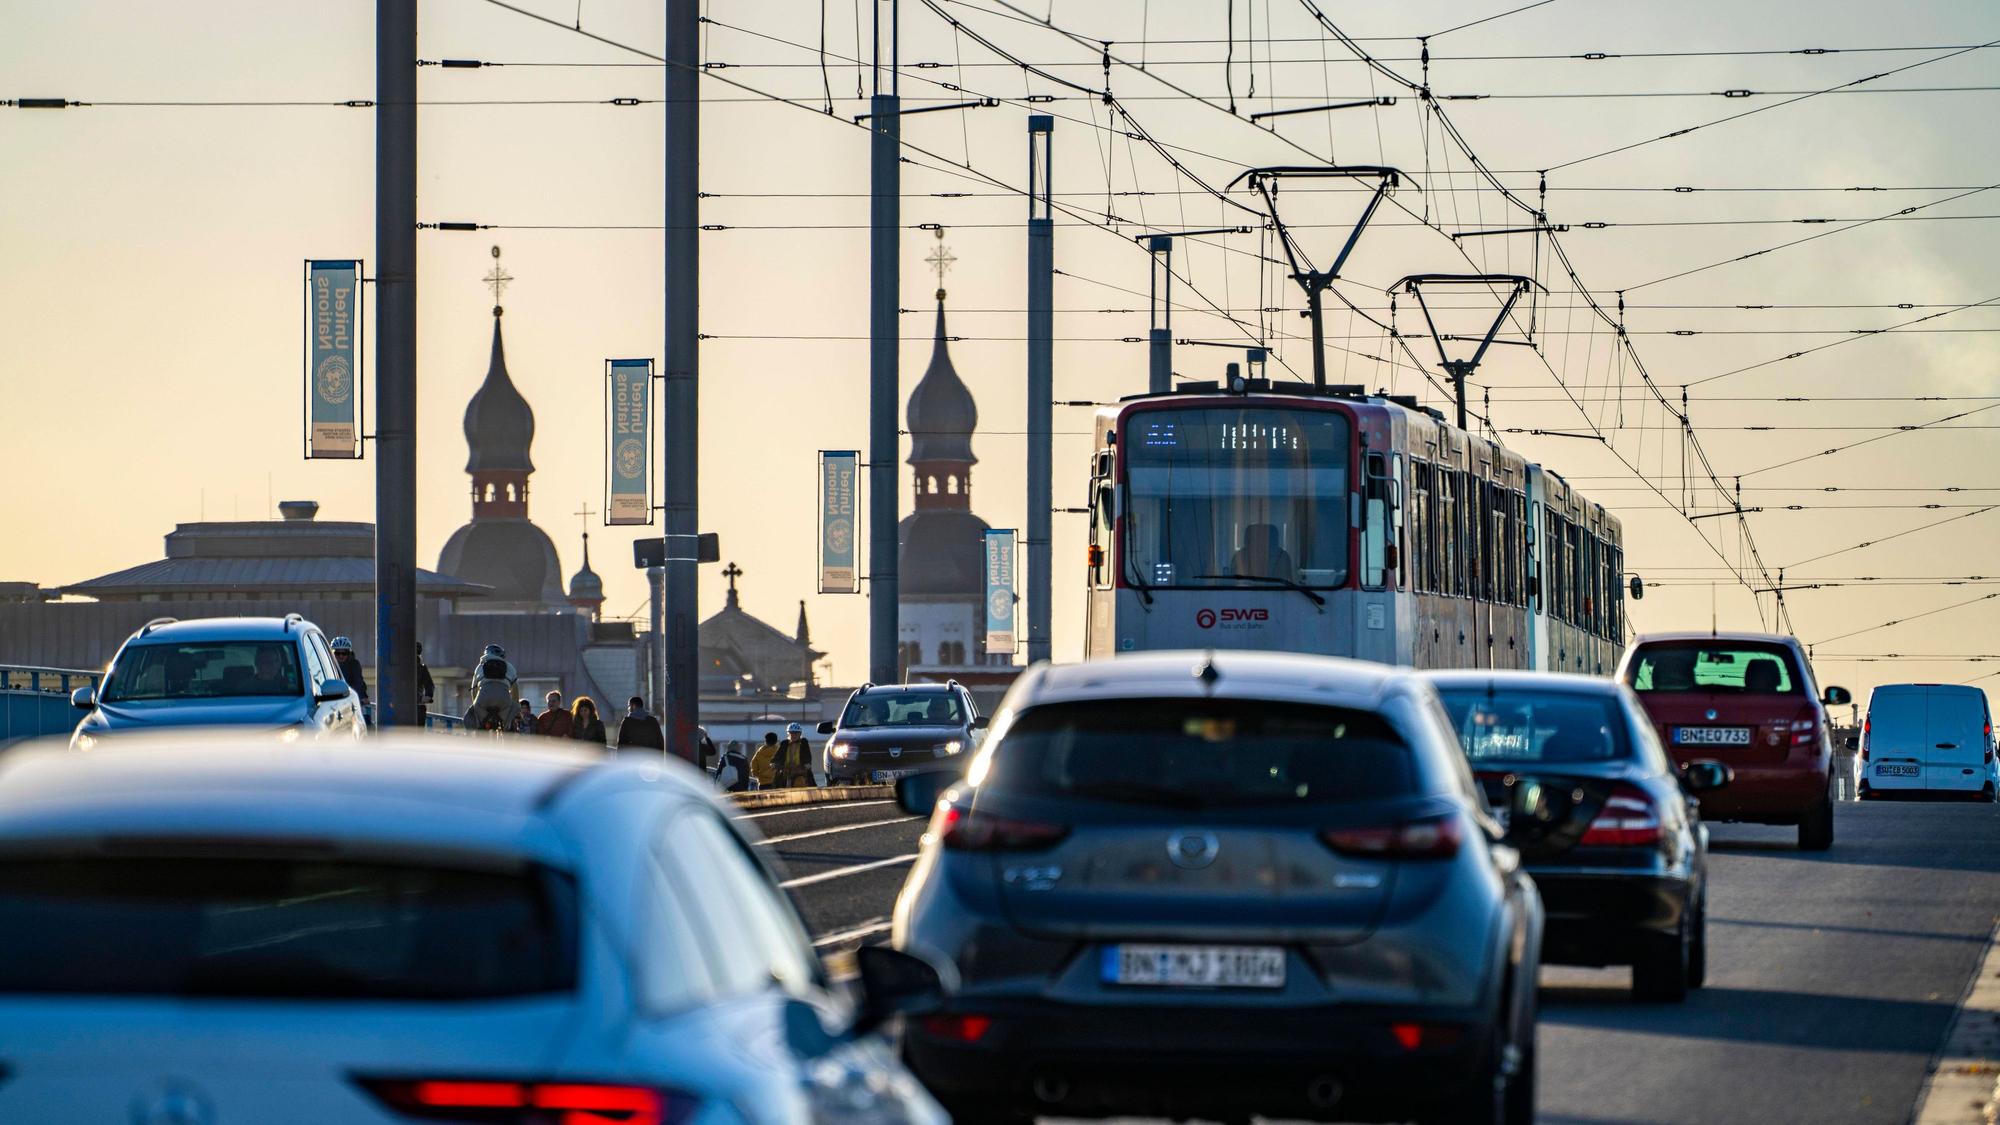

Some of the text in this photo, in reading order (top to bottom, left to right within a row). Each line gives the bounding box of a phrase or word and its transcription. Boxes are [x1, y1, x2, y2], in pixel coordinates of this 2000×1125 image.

[1221, 609, 1269, 620] SWB
[1680, 730, 1699, 742] BN
[1725, 730, 1748, 742] 733
